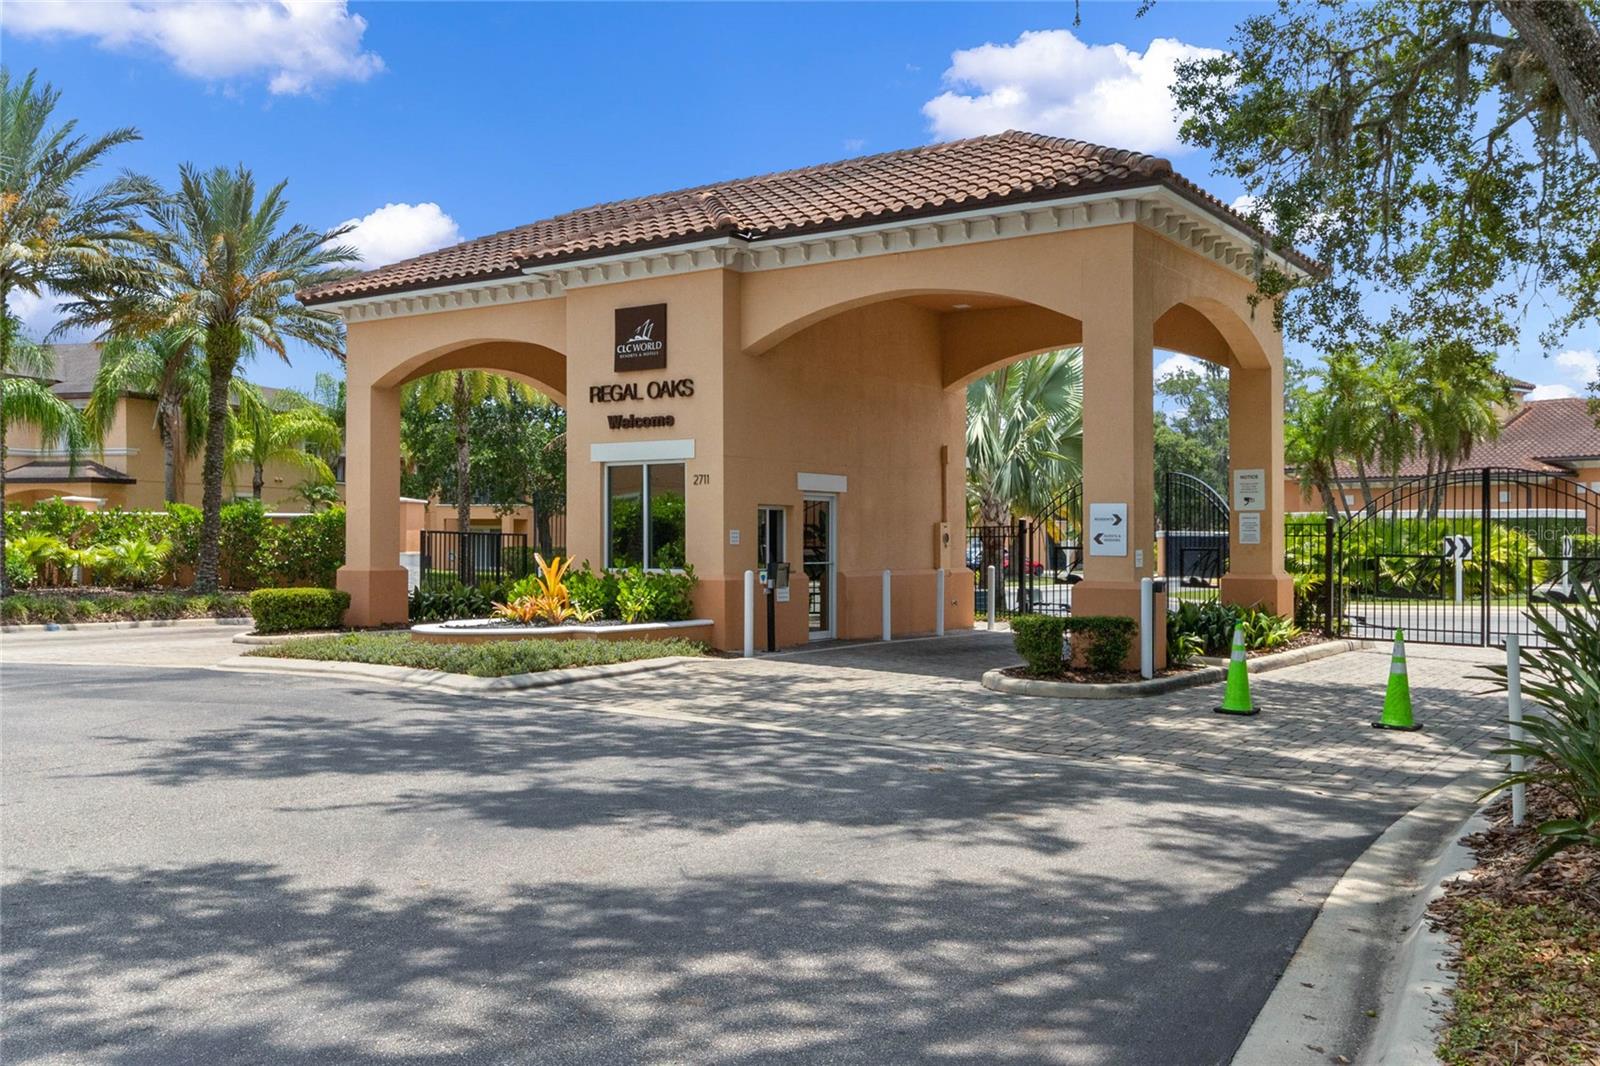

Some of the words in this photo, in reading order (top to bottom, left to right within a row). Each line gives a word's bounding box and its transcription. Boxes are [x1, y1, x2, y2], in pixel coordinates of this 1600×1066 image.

[616, 344, 632, 354] CLC
[632, 341, 662, 352] WORLD
[589, 382, 644, 404] REGAL
[646, 378, 695, 400] OAKS
[607, 414, 675, 430] Welcome
[693, 474, 710, 486] 2711
